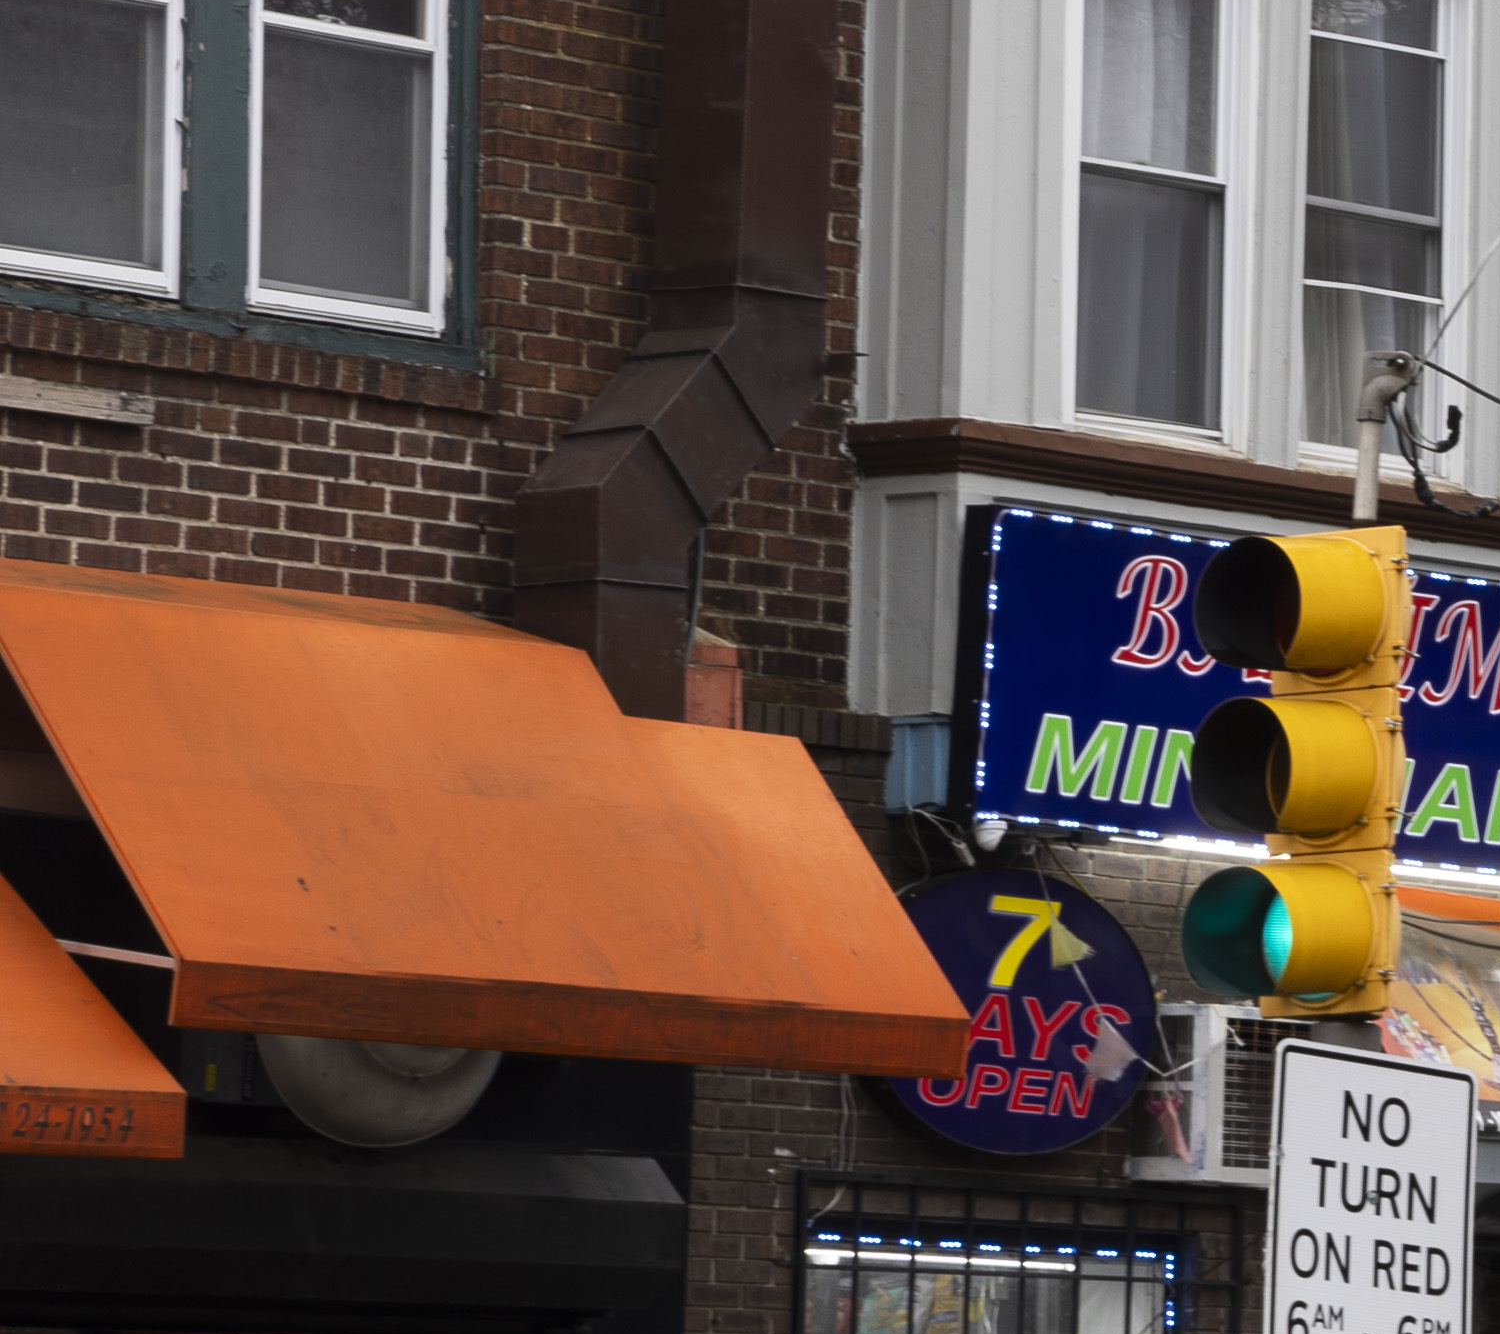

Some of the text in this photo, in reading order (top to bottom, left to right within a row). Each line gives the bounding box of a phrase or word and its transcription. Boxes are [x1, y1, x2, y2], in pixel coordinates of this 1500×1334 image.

[1025, 712, 1196, 809] MIN
[989, 894, 1062, 988] 7
[966, 993, 1132, 1065] AYS
[1341, 1089, 1411, 1147] NO
[1310, 1156, 1438, 1225] TURN
[1290, 1227, 1451, 1296] ON RED
